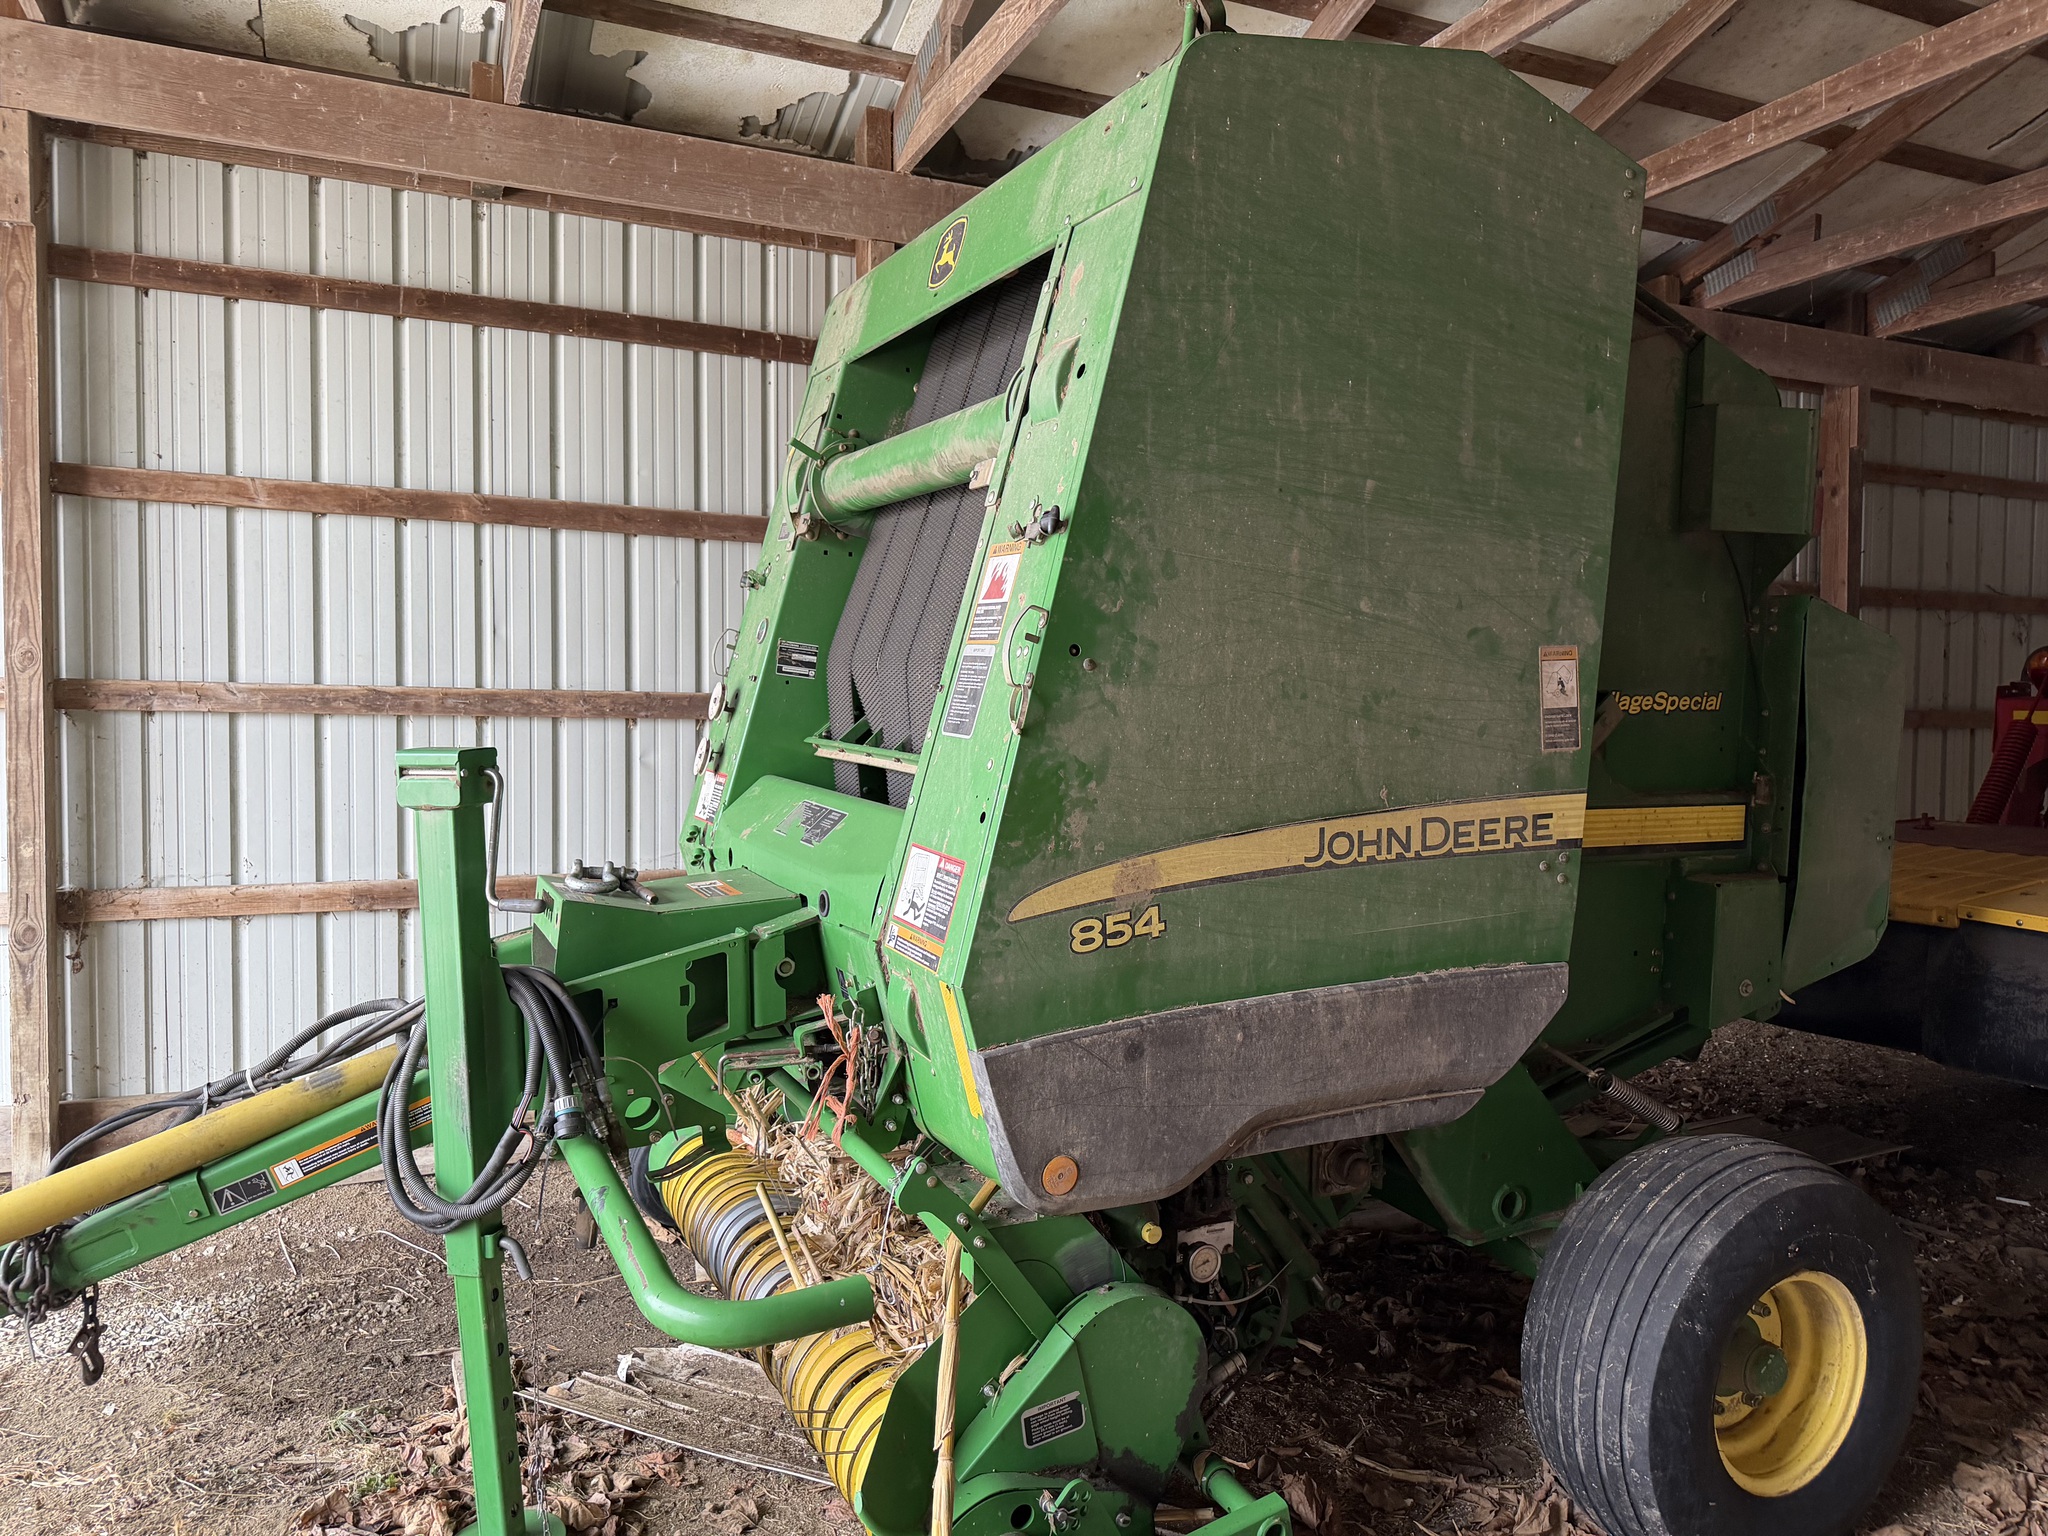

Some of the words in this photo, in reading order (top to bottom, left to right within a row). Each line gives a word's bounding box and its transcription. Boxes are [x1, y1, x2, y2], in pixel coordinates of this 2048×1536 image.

[1614, 691, 1723, 715] lageSpecial
[1303, 825, 1413, 865] JOHN
[1420, 812, 1555, 853] DEERE
[1070, 904, 1167, 954] 854
[1037, 1397, 1066, 1411] IMPORTANT
